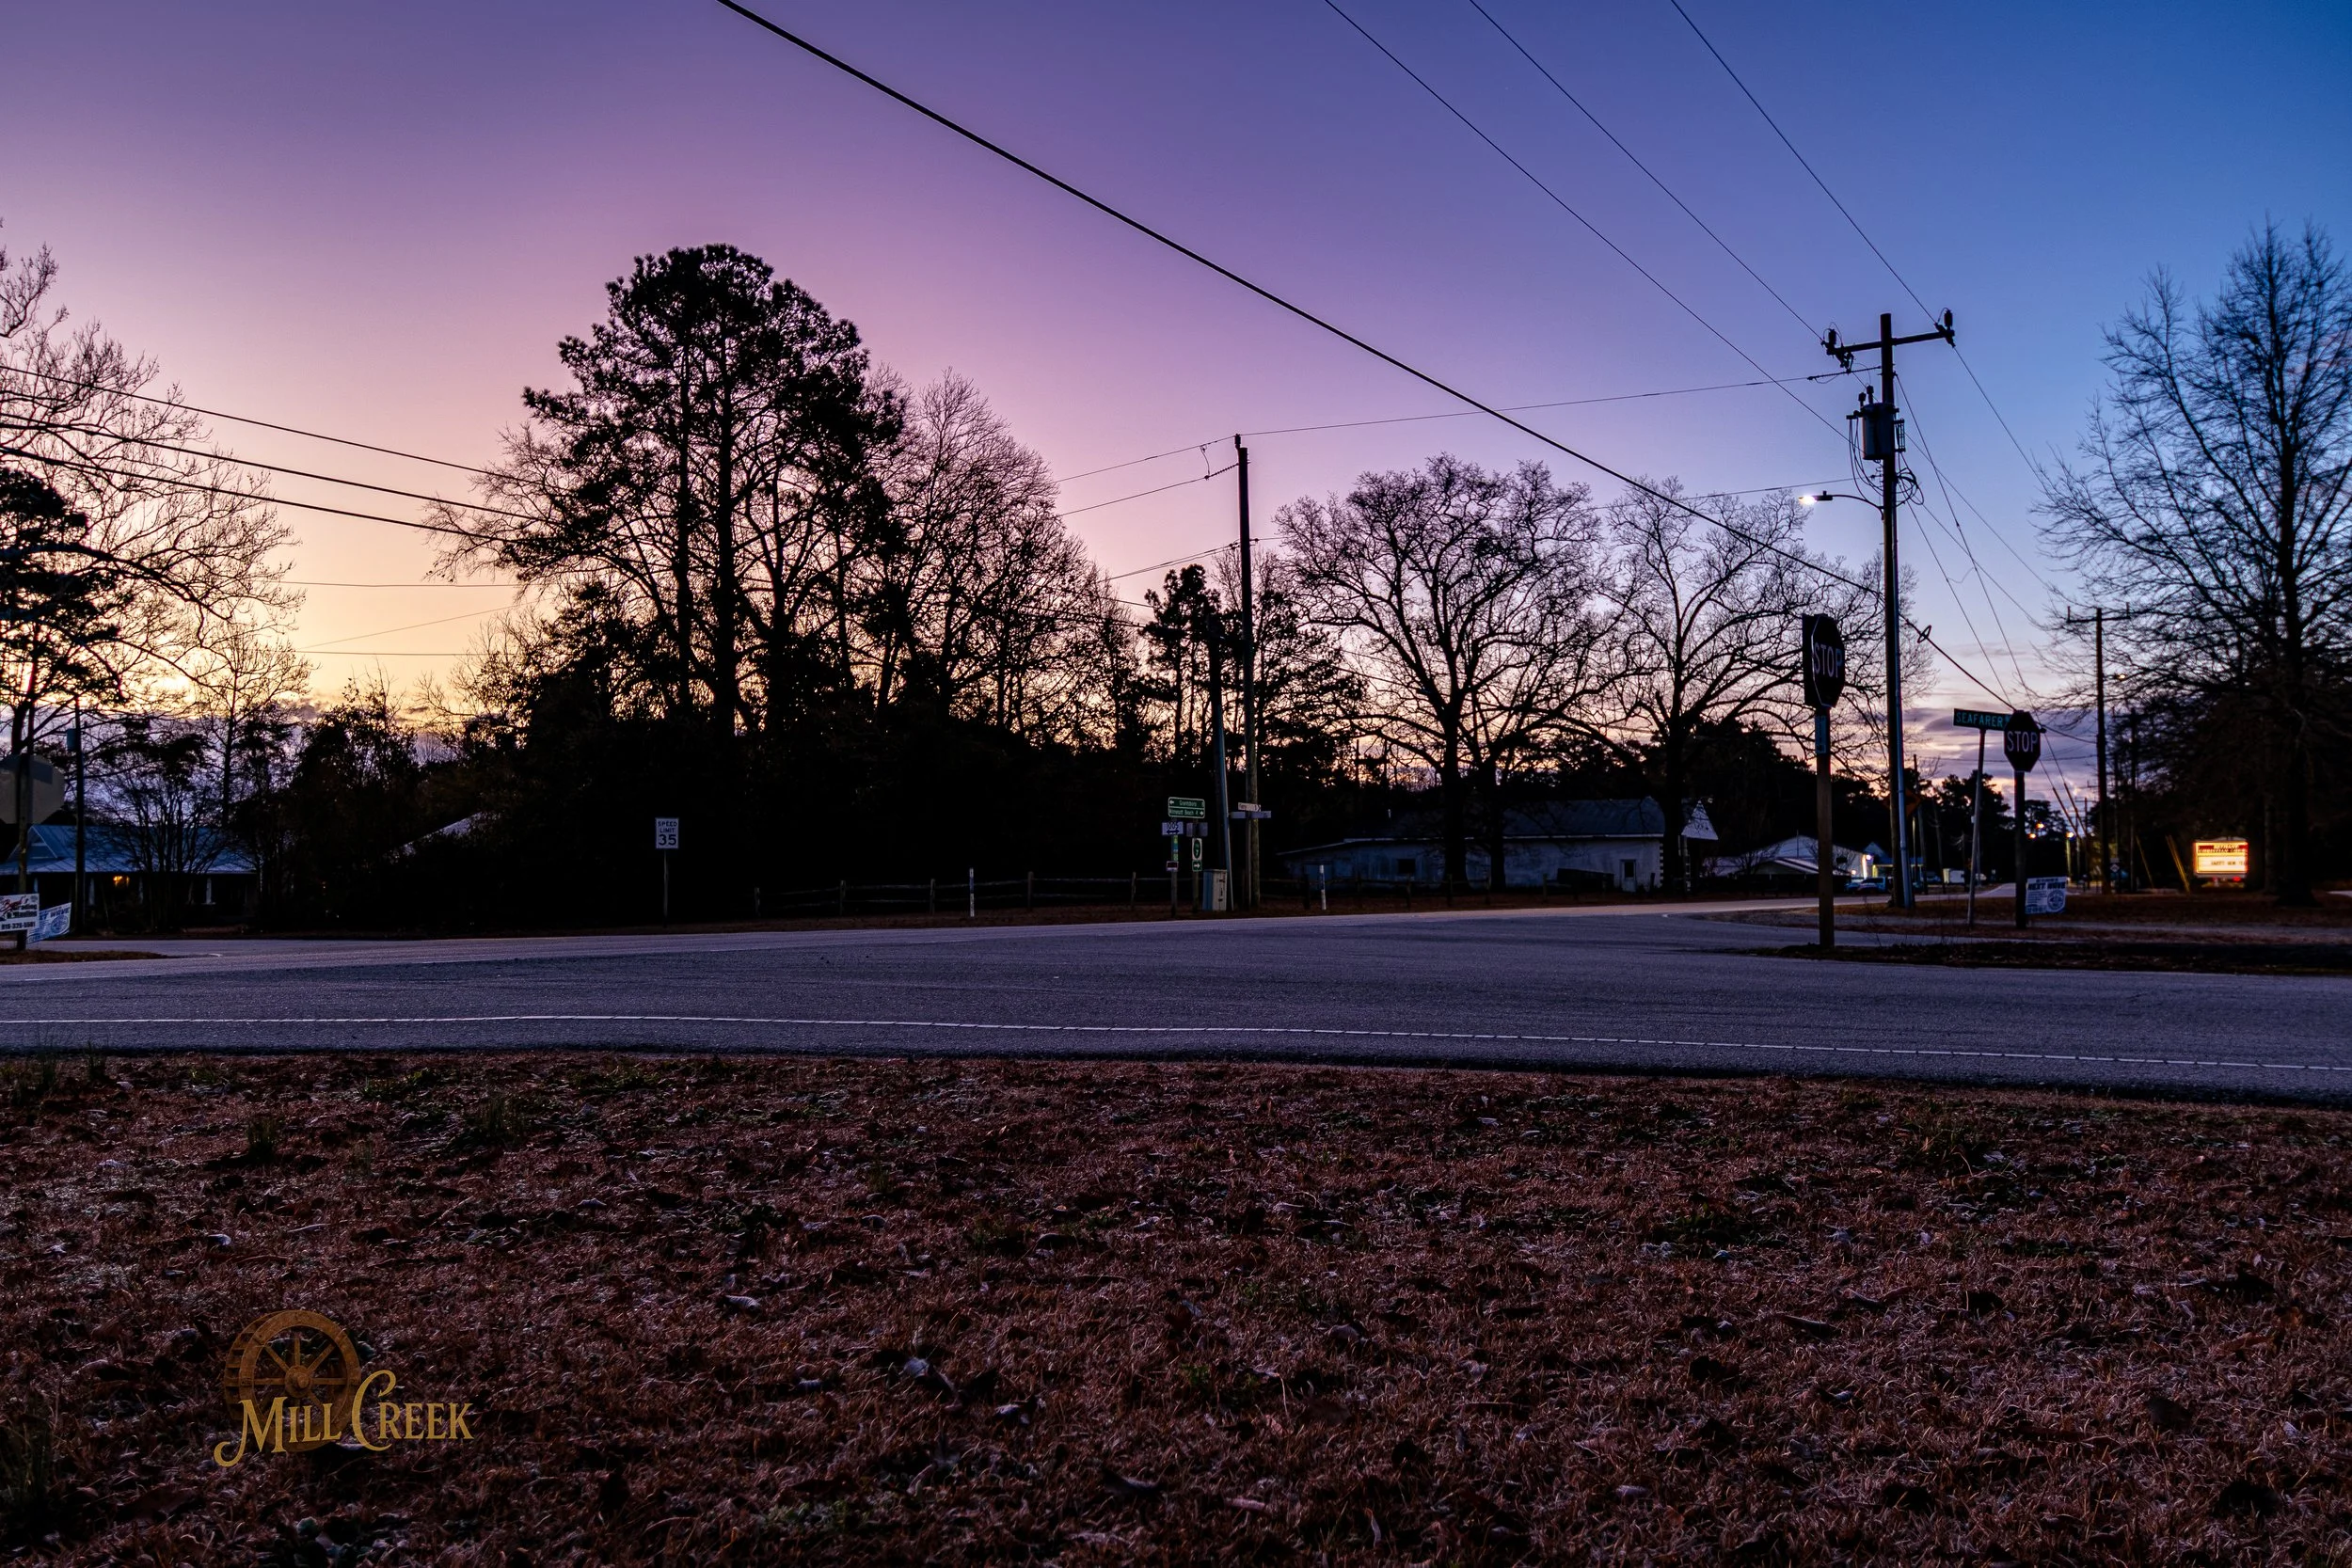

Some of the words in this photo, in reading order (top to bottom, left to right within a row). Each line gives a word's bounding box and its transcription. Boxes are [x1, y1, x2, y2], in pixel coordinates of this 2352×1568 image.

[1814, 641, 1843, 679] STOP
[1956, 711, 2004, 729] SEAFARER
[2007, 730, 2039, 753] STOP
[659, 833, 676, 846] 35
